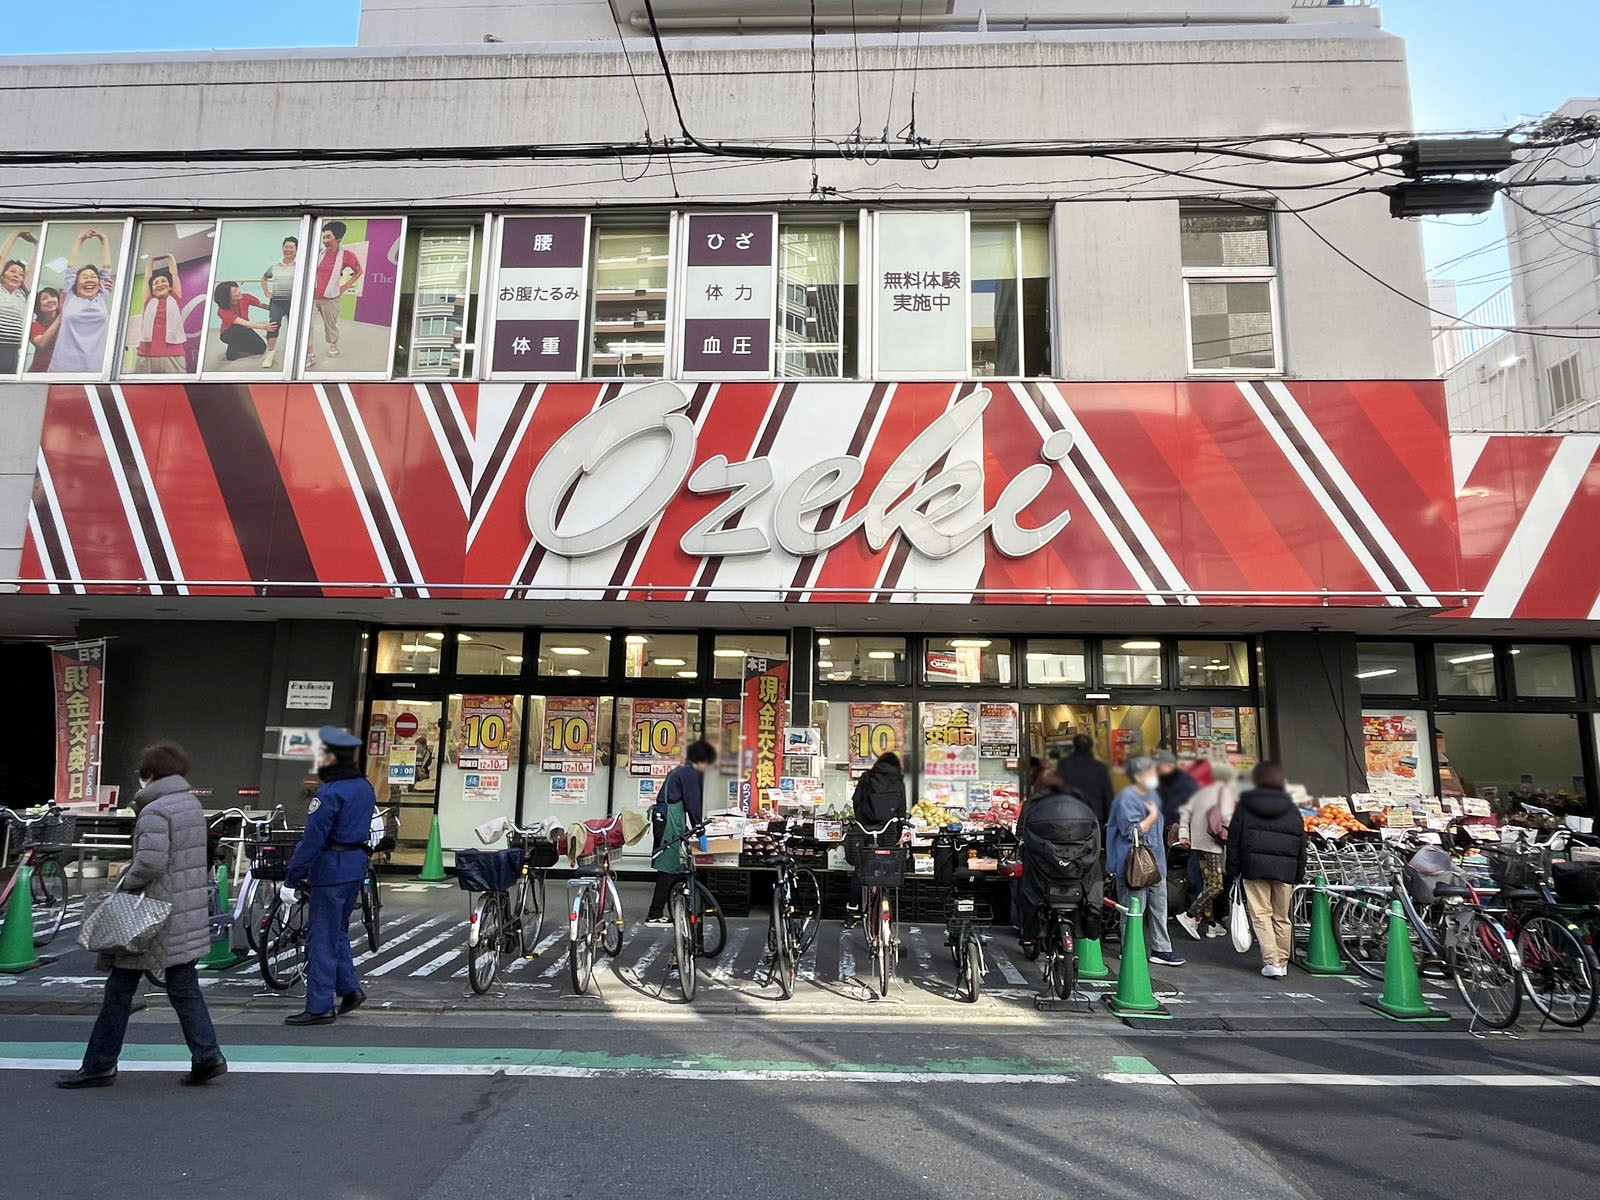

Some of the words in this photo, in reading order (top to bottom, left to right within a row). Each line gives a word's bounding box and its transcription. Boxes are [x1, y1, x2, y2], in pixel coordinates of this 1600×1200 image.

[533, 234, 553, 251] 腰
[371, 272, 393, 283] The
[883, 270, 961, 290] 無料体験
[499, 286, 580, 301] お腹たるみ
[892, 293, 951, 312] 実施中
[525, 381, 1072, 559] Ozeki
[747, 657, 767, 672] 本日
[757, 675, 779, 814] 現金交換日
